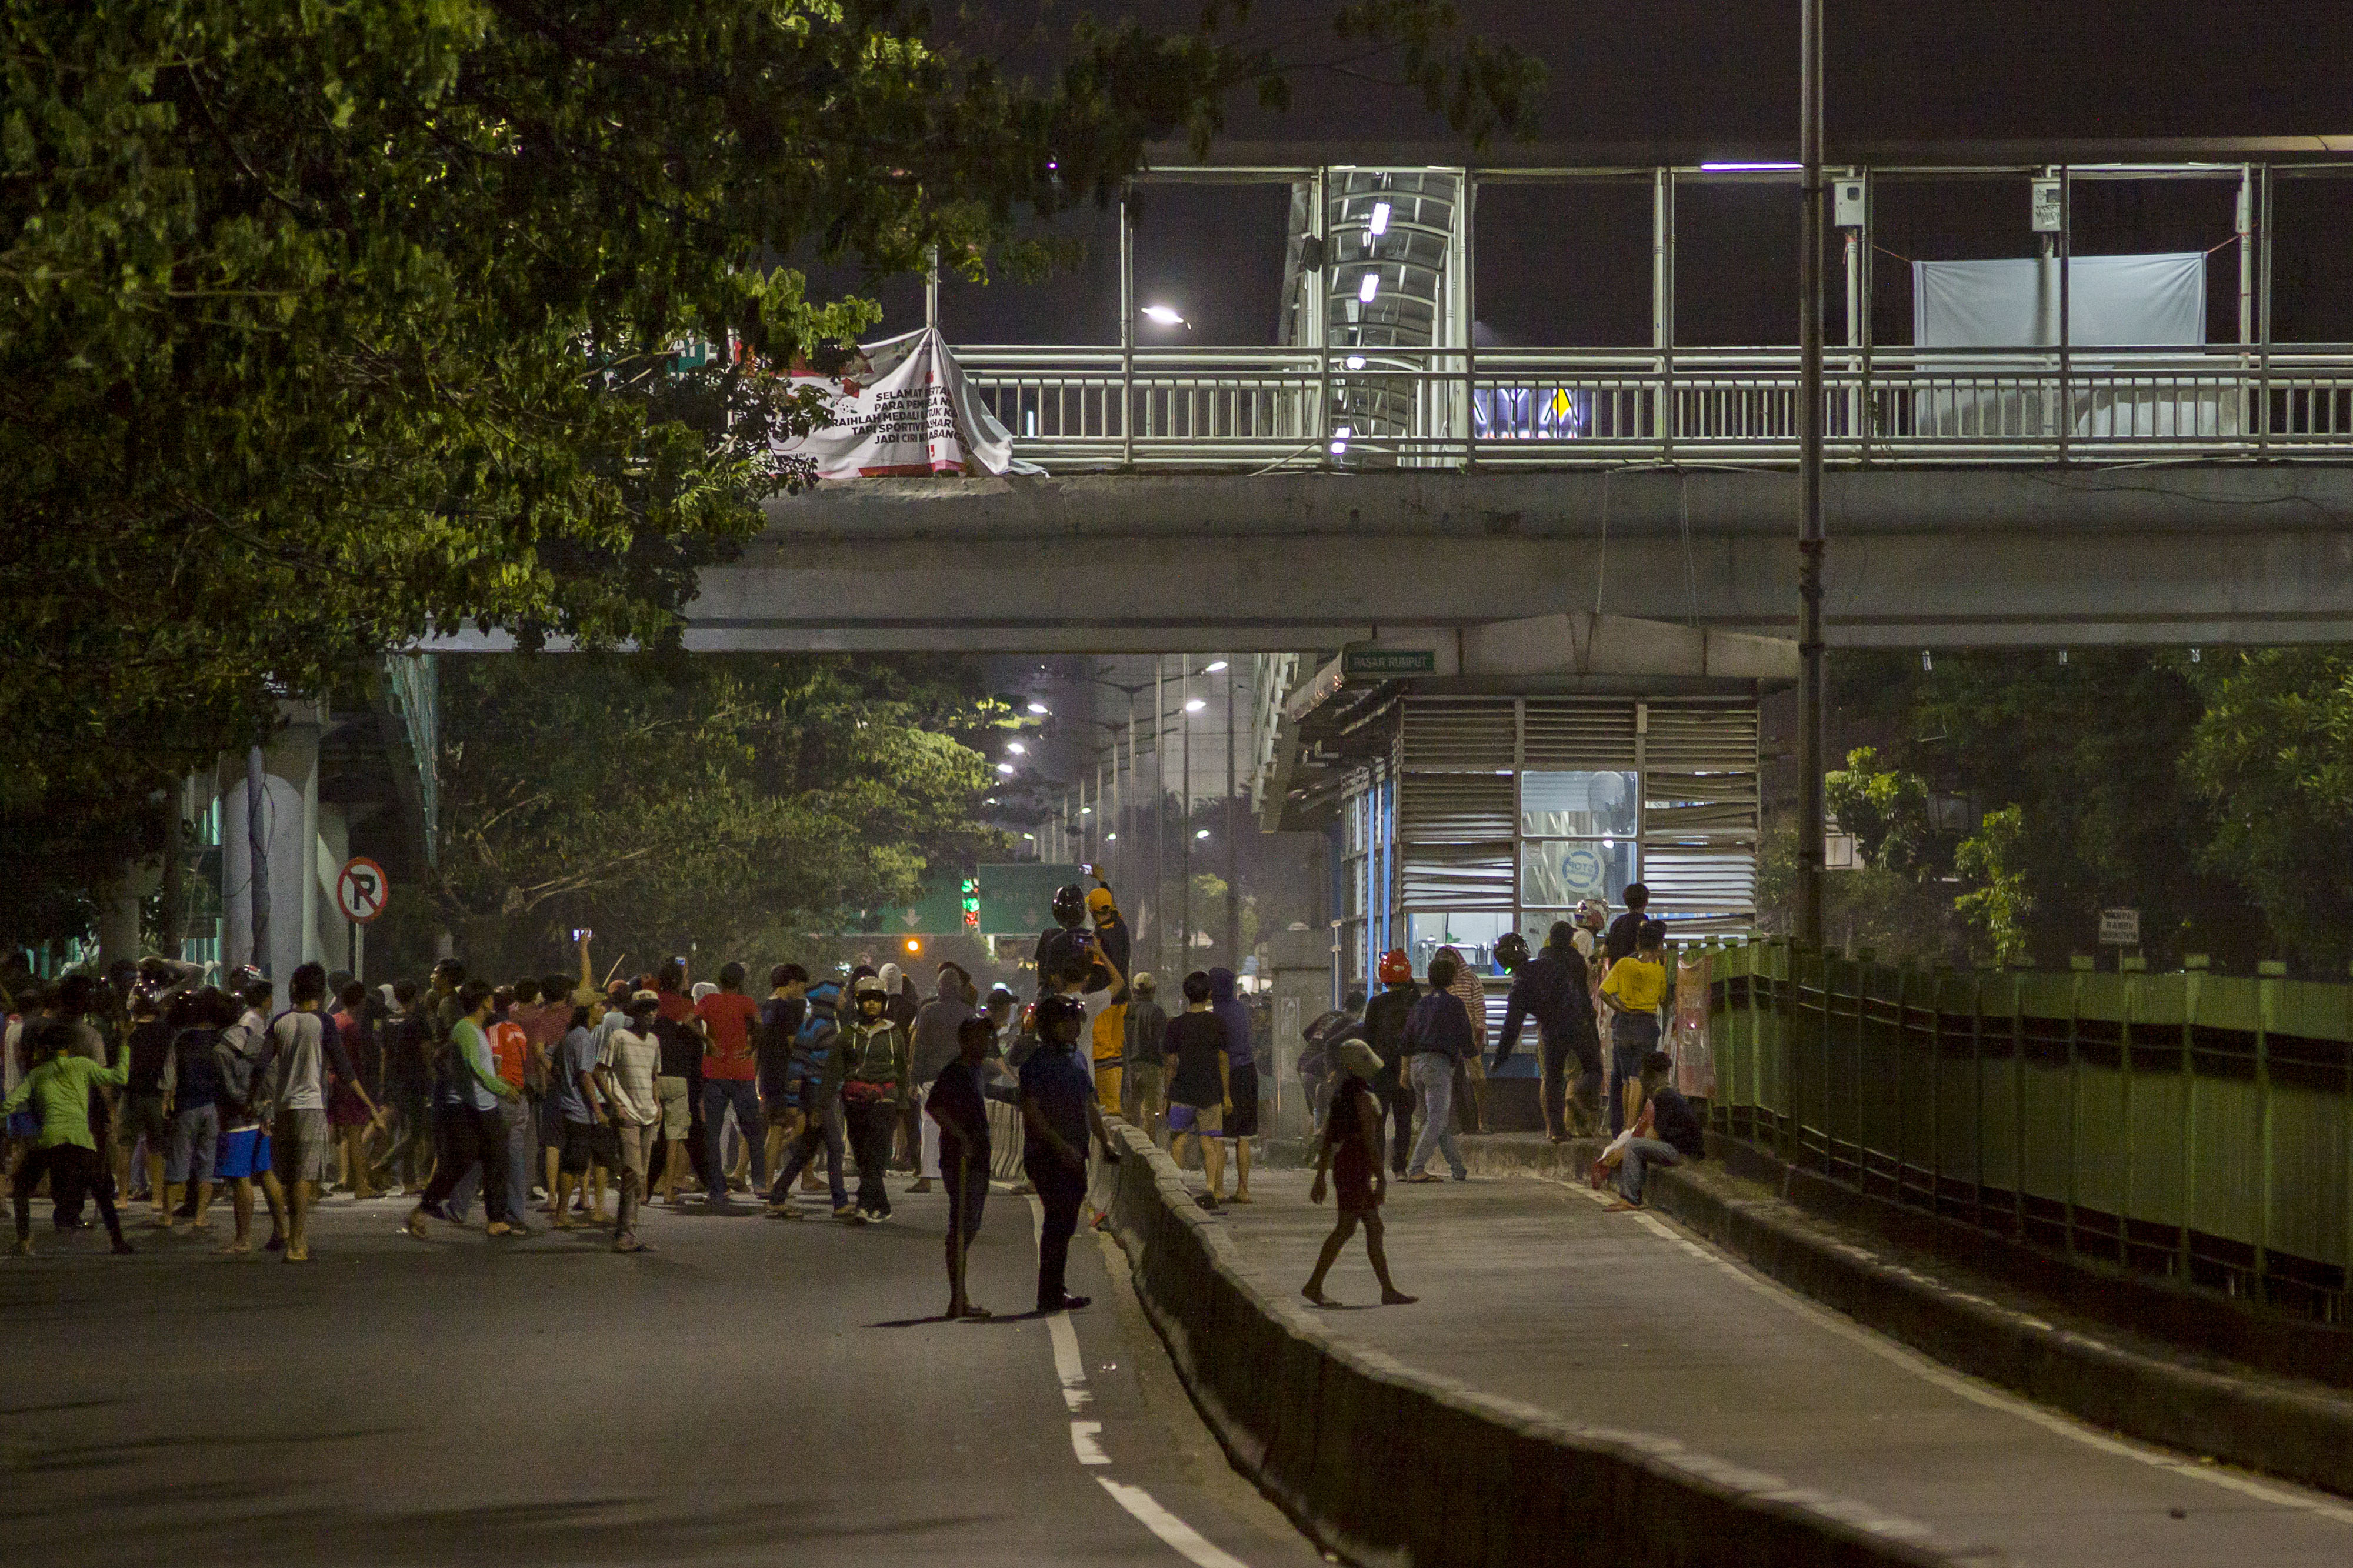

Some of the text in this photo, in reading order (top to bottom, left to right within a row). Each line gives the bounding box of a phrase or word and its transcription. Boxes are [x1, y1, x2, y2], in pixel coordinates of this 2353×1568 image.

[876, 388, 923, 401] SELAMAT
[875, 401, 904, 412] PARA
[833, 413, 881, 426] RAIHLAH
[883, 411, 919, 422] MEDALI
[851, 425, 876, 435] TAPI
[874, 435, 899, 445] JADI
[901, 433, 917, 443] CIRI
[1353, 656, 1427, 668] PASAR RUMPUT
[353, 873, 376, 910] P
